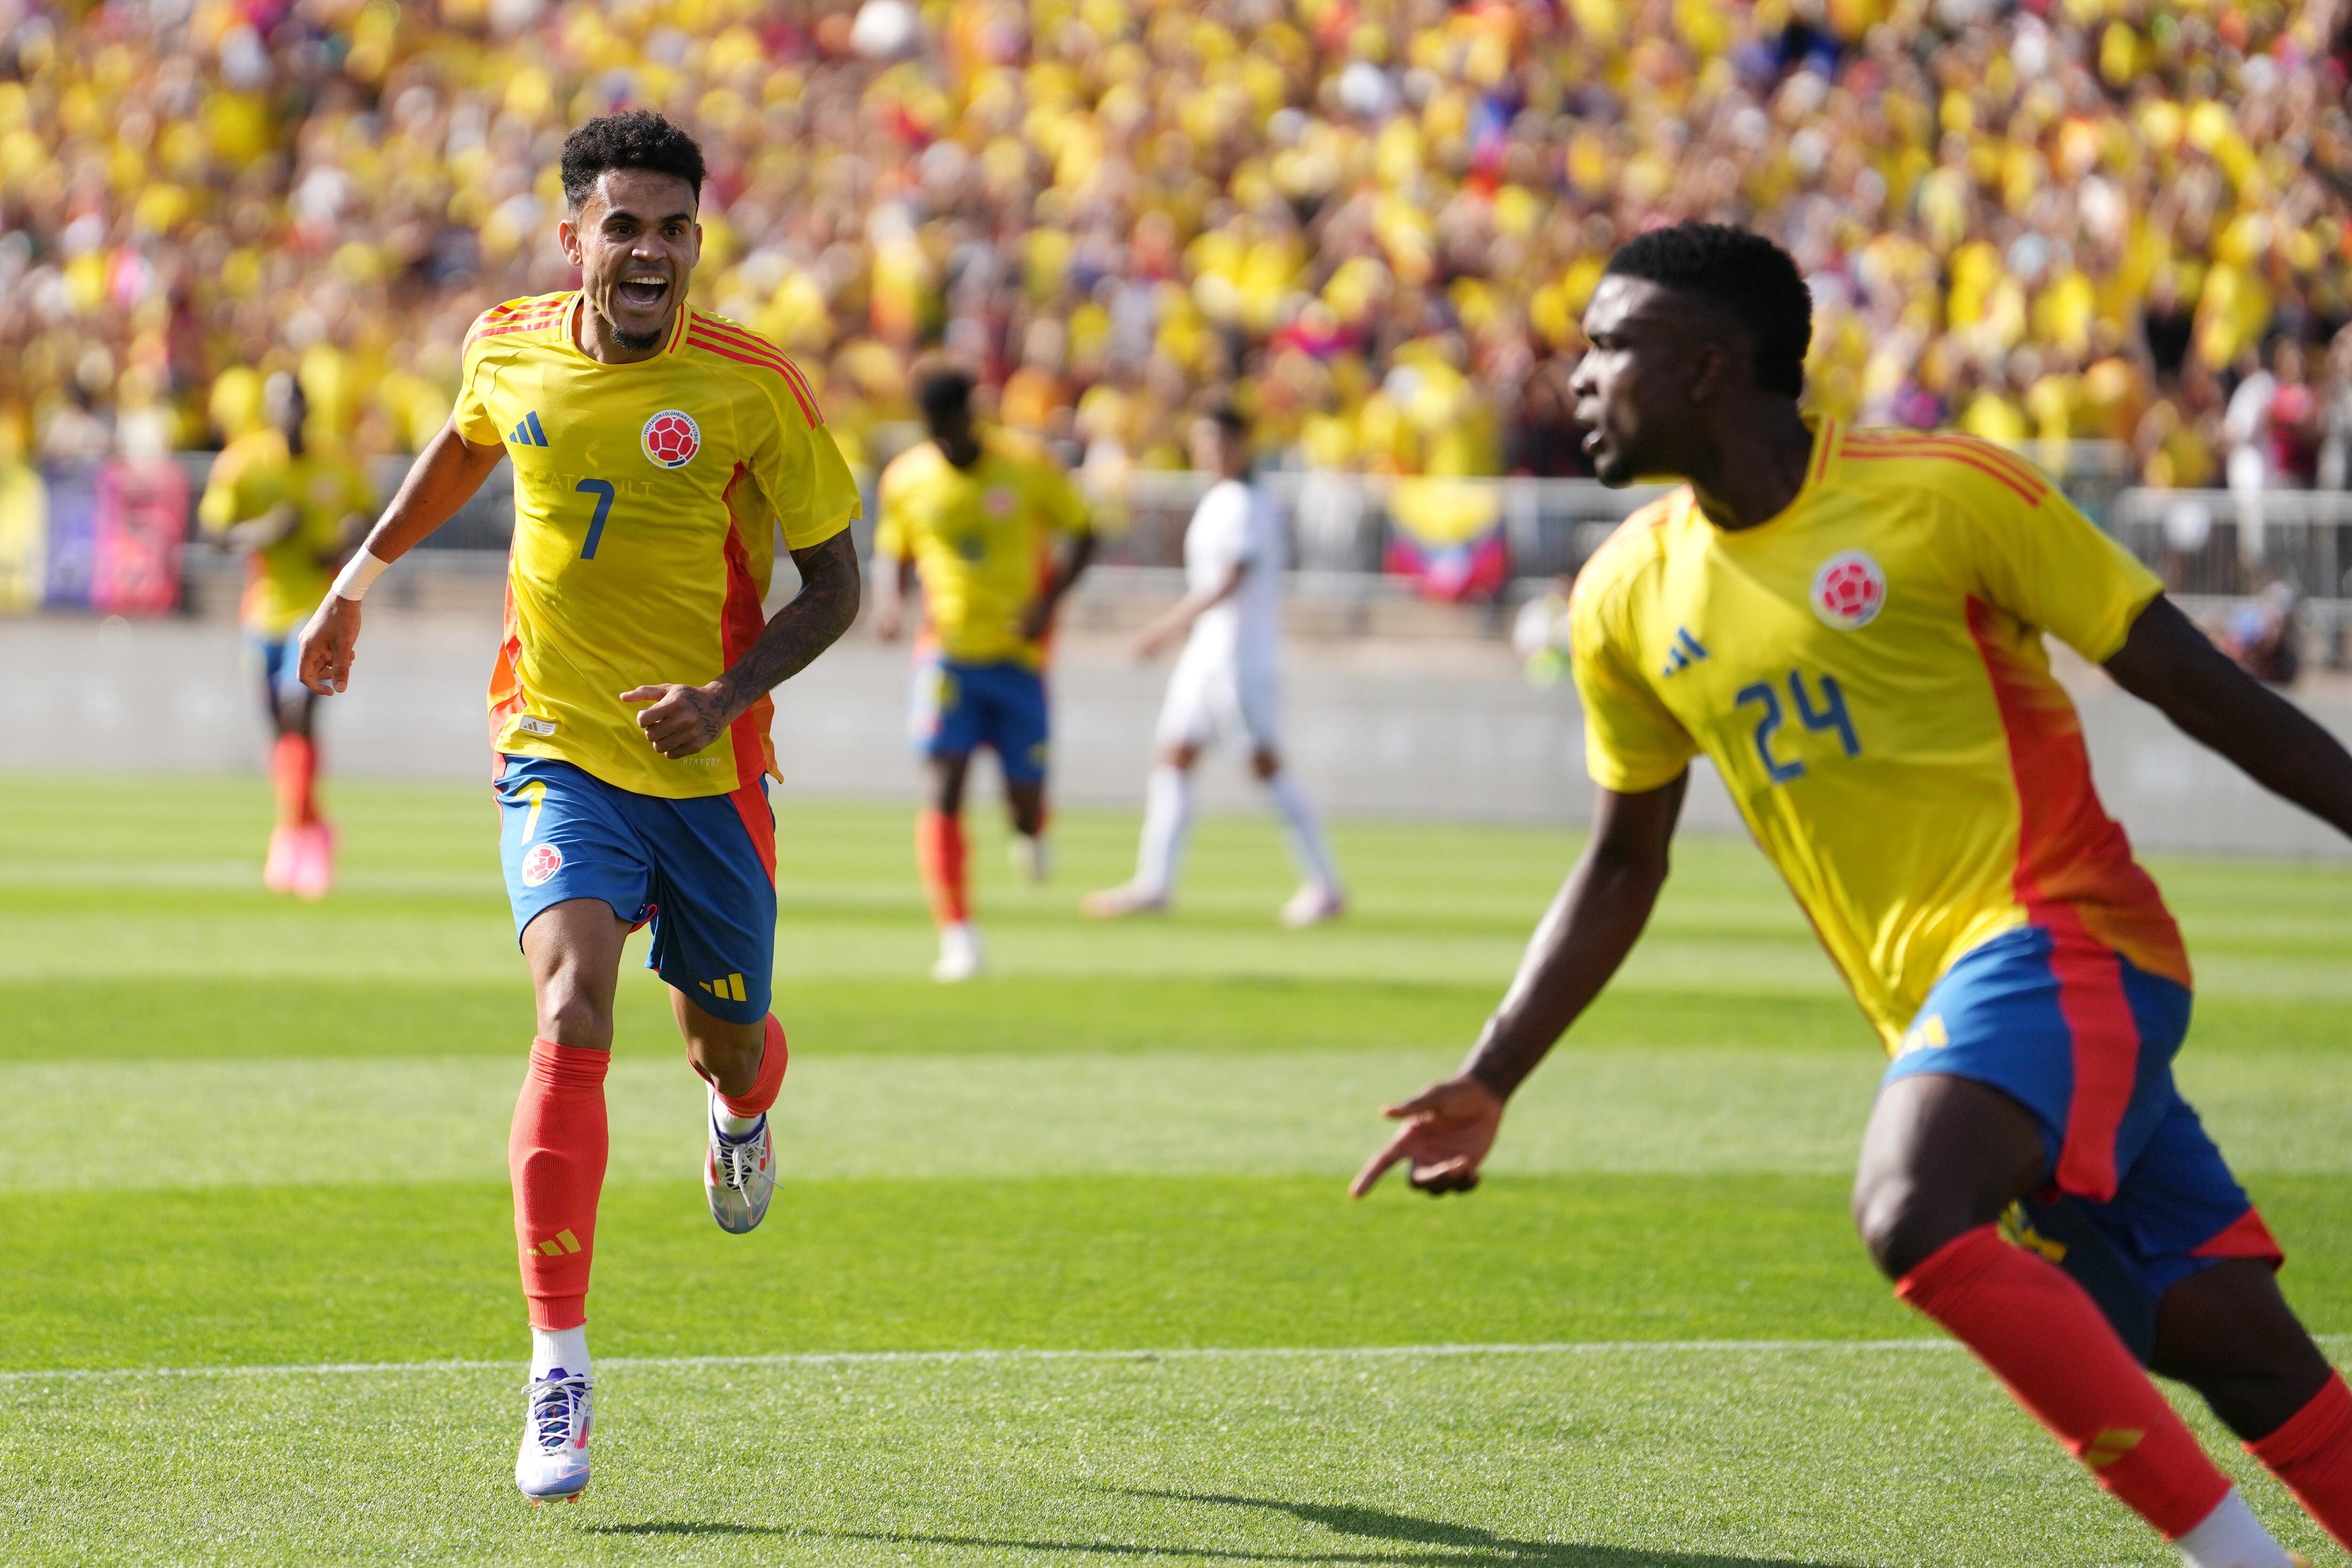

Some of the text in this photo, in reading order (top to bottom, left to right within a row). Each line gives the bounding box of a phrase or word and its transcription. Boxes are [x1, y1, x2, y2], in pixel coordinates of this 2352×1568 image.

[662, 411, 689, 422] COLOMBIANA
[575, 478, 615, 559] 7
[1736, 669, 1861, 783] 24
[508, 781, 547, 846] 7
